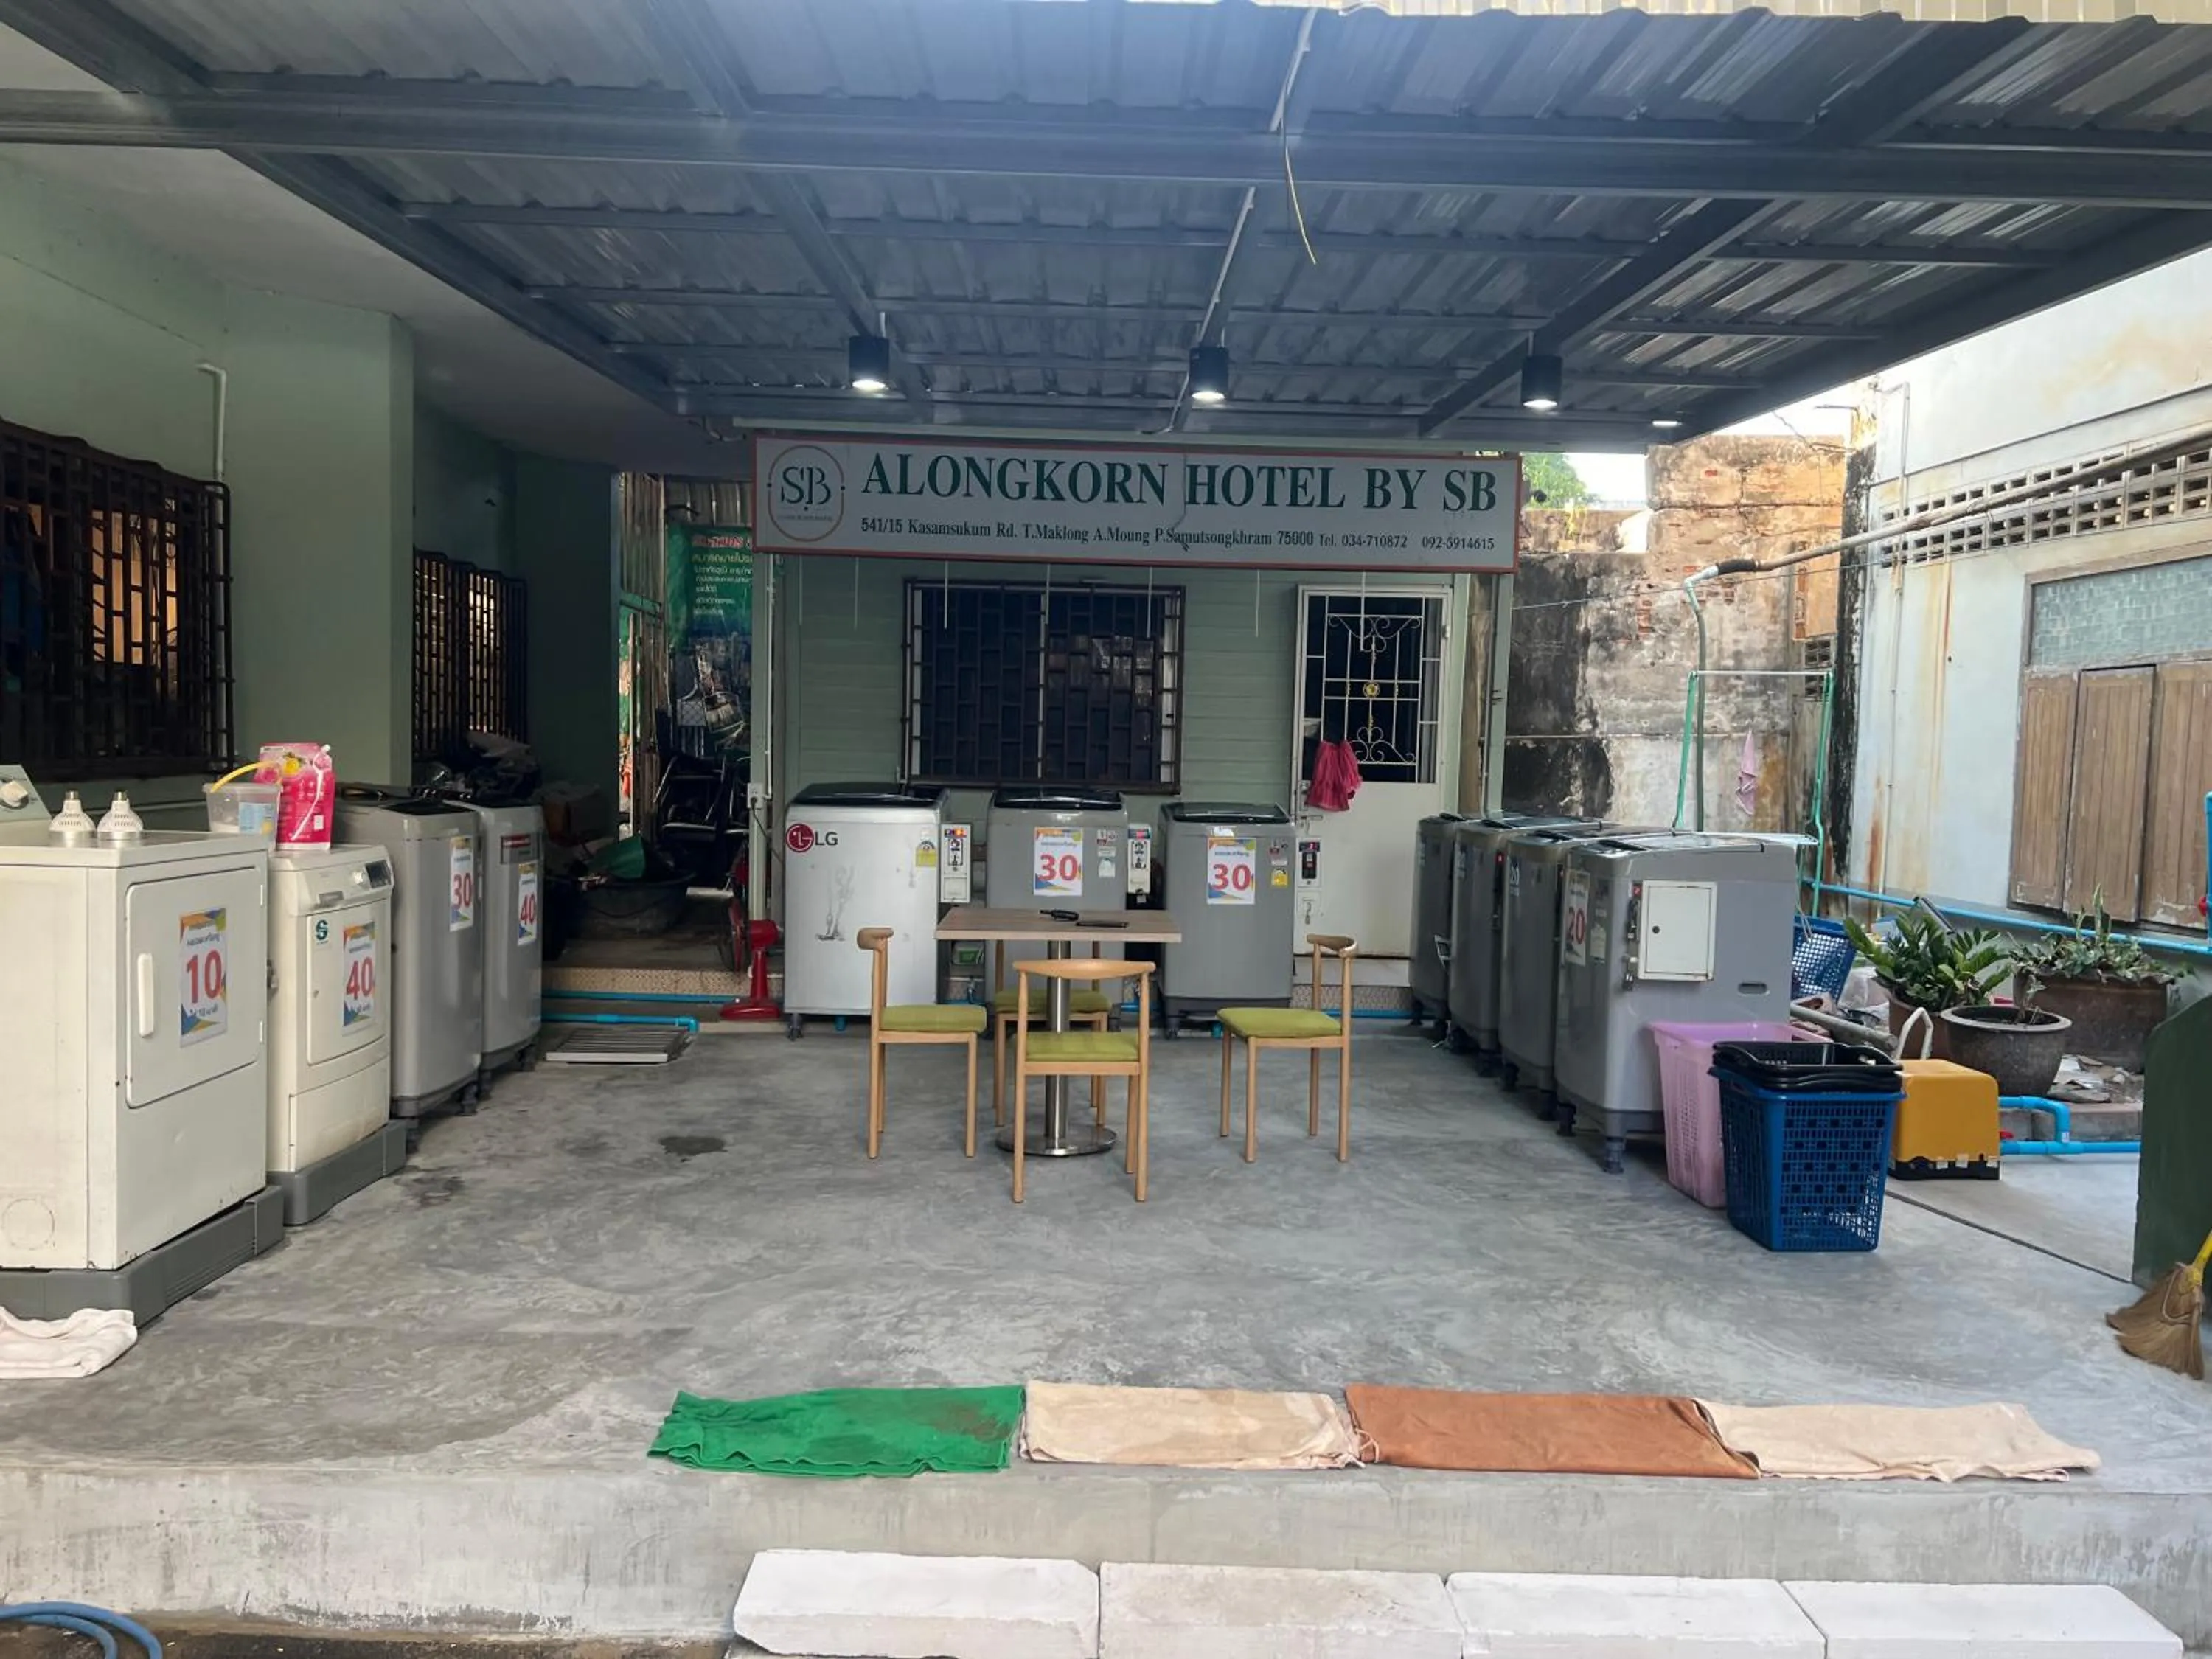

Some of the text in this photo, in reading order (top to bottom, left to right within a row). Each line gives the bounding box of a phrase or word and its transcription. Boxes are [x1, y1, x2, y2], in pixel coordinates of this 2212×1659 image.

[780, 466, 832, 505] SB
[861, 452, 1498, 512] ALONGKORN HOTEL BY SB
[860, 517, 903, 534] 541/15
[908, 518, 991, 537] Kasamsukum
[996, 521, 1018, 538] Rd.
[1022, 523, 1089, 544] T.Maklong
[1092, 526, 1150, 547] A.Moung
[1276, 529, 1315, 546] 75000
[1318, 532, 1337, 548] Tel.
[1341, 533, 1408, 549] 034-710872
[814, 831, 838, 846] LG
[1038, 854, 1078, 882] 30
[1212, 863, 1251, 891] 30
[453, 872, 473, 910] 30
[520, 893, 536, 925] 40
[1568, 906, 1585, 945] 20
[186, 949, 222, 1004] 10
[346, 956, 373, 1001] 40
